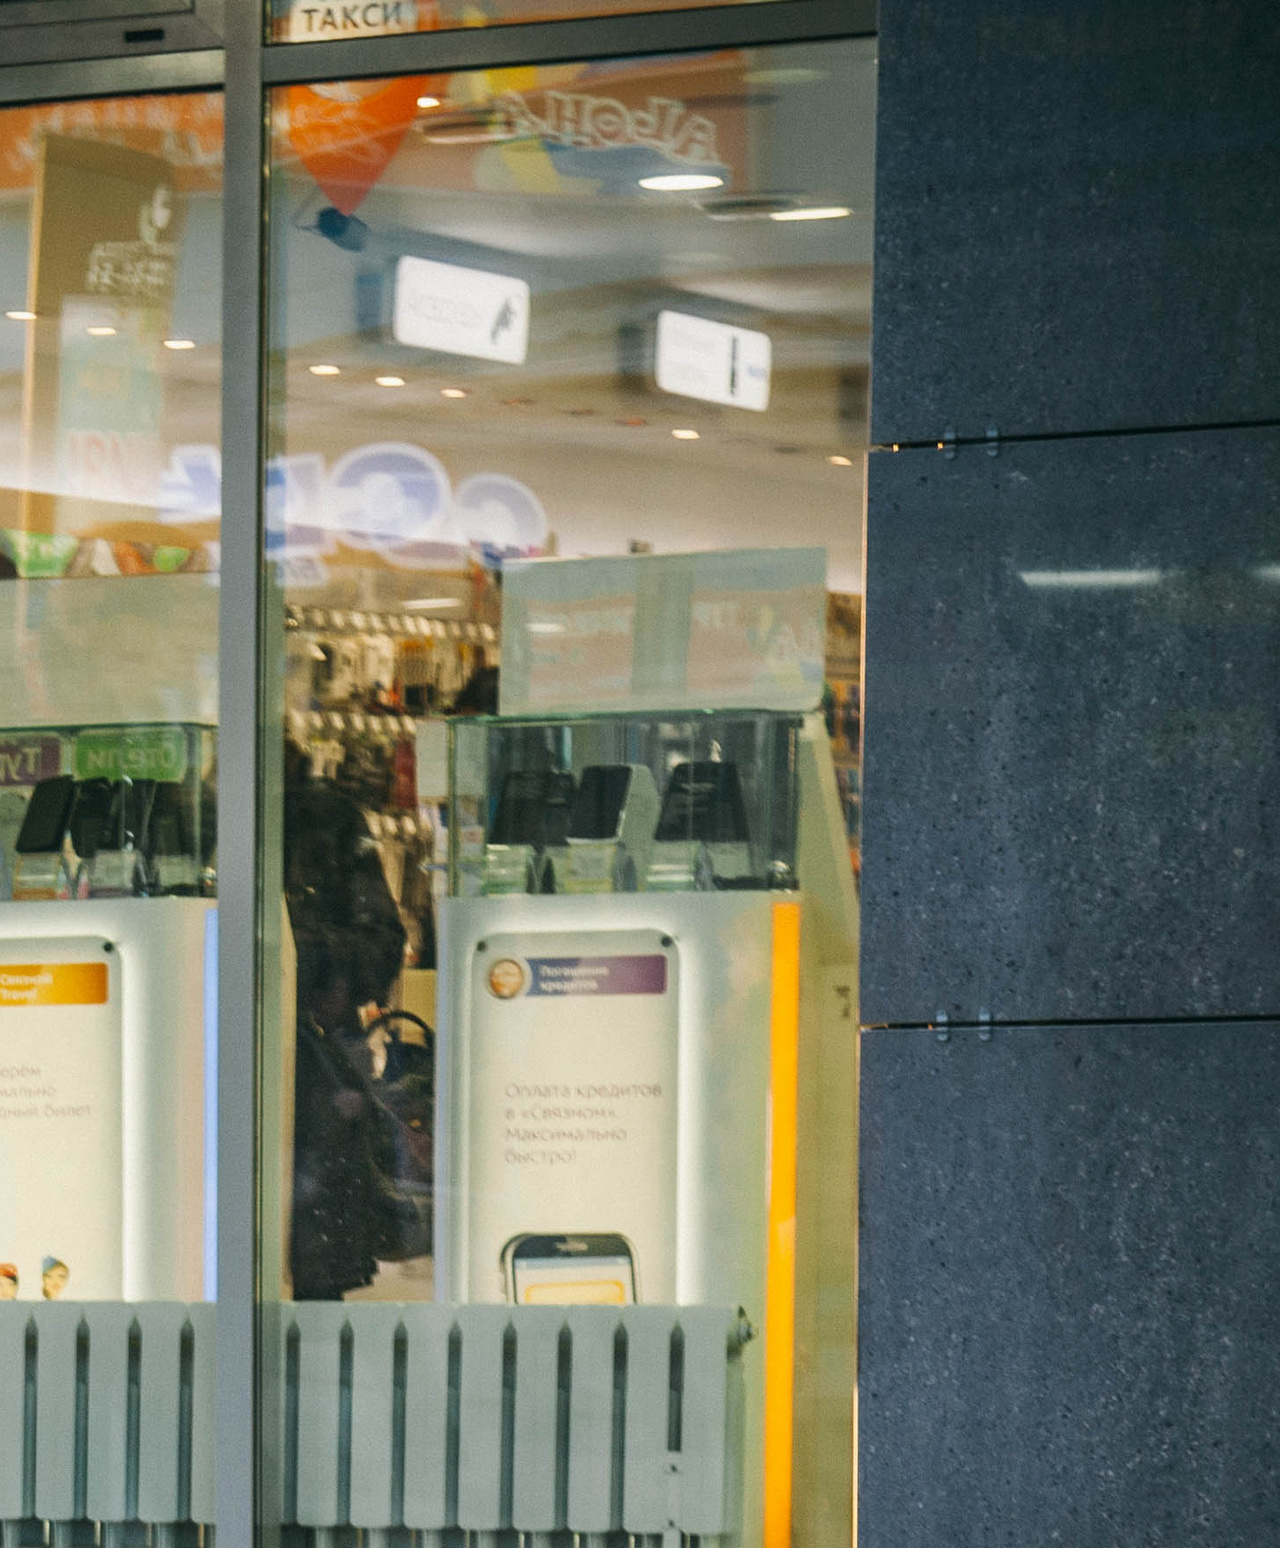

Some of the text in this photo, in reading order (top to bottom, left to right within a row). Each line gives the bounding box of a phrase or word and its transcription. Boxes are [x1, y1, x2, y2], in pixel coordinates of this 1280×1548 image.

[302, 2, 402, 33] ТАКСИ
[505, 1082, 663, 1099] Оплата кредитов
